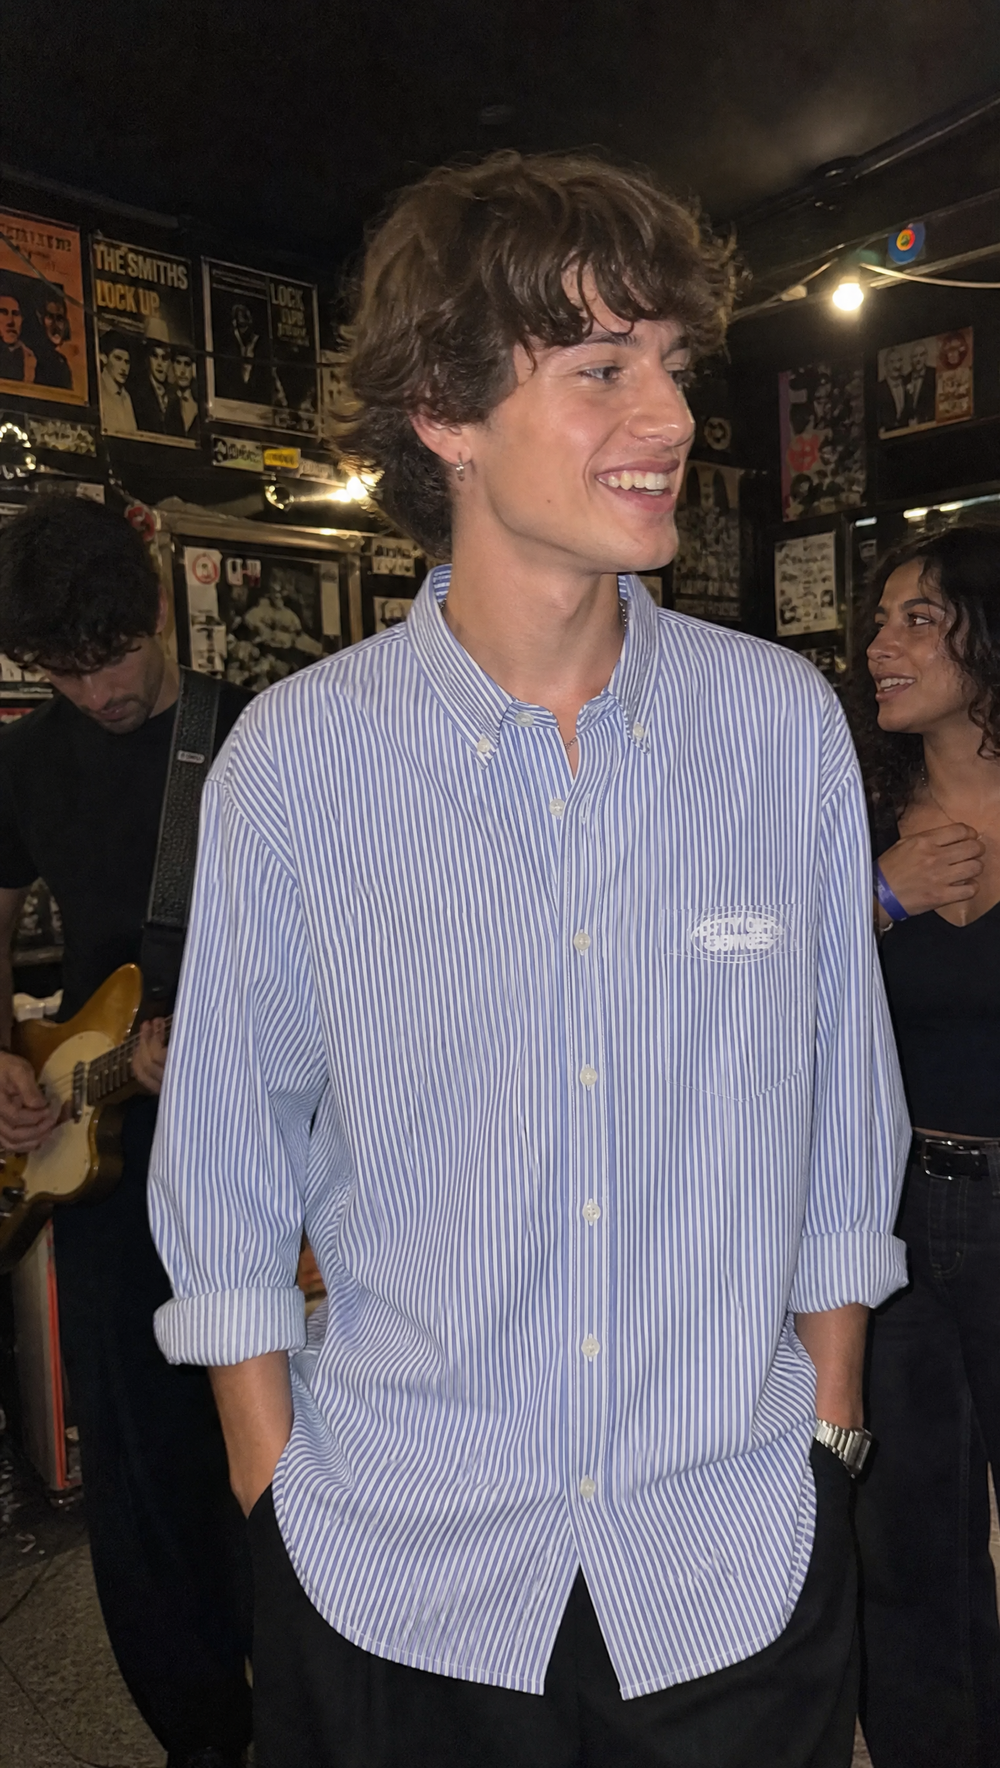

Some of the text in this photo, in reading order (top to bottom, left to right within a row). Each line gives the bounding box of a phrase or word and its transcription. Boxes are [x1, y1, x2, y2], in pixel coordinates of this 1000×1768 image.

[94, 244, 126, 275] THE
[127, 252, 188, 290] SMITHS
[96, 279, 137, 313] LOCK
